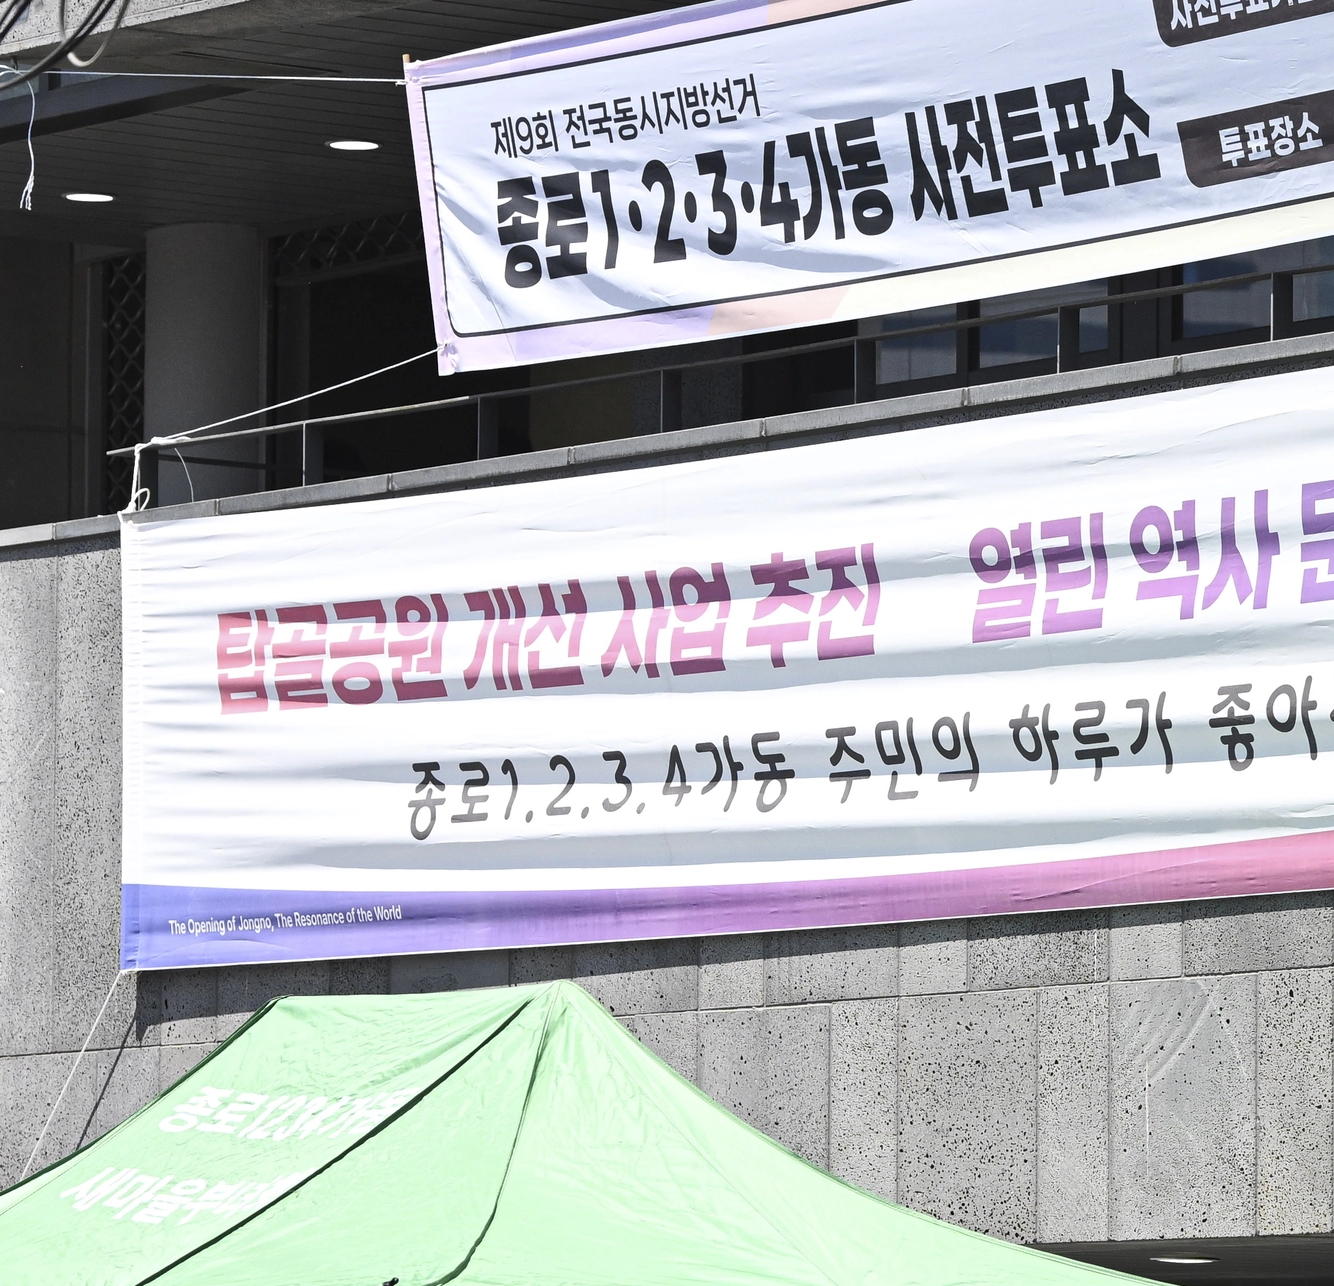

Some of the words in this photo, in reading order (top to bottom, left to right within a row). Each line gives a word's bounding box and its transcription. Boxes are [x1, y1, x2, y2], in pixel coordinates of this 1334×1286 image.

[491, 107, 559, 158] 제9회
[565, 75, 761, 150] 전국동시지방선거
[1219, 112, 1324, 167] 투표장소
[496, 116, 895, 290] 종로1·2·3·4가동
[906, 69, 1162, 221] 사전투표소
[216, 594, 450, 716] 탑골공원
[463, 578, 586, 690] 개선
[600, 561, 733, 680] 사업
[745, 542, 882, 668] 추진
[969, 511, 1110, 644] 열린
[1131, 488, 1281, 619] 역사
[408, 731, 797, 842] 종로1.2.3.4가동
[827, 710, 981, 802] 주민의
[1009, 690, 1175, 786] 하루가
[168, 918, 187, 936] The
[187, 917, 226, 937] Opening
[227, 915, 237, 932] of
[238, 912, 275, 934] Jongno,
[274, 911, 293, 930] The
[294, 907, 345, 927] Resonance
[346, 906, 357, 924] of
[357, 905, 373, 922] the
[374, 904, 403, 921] World
